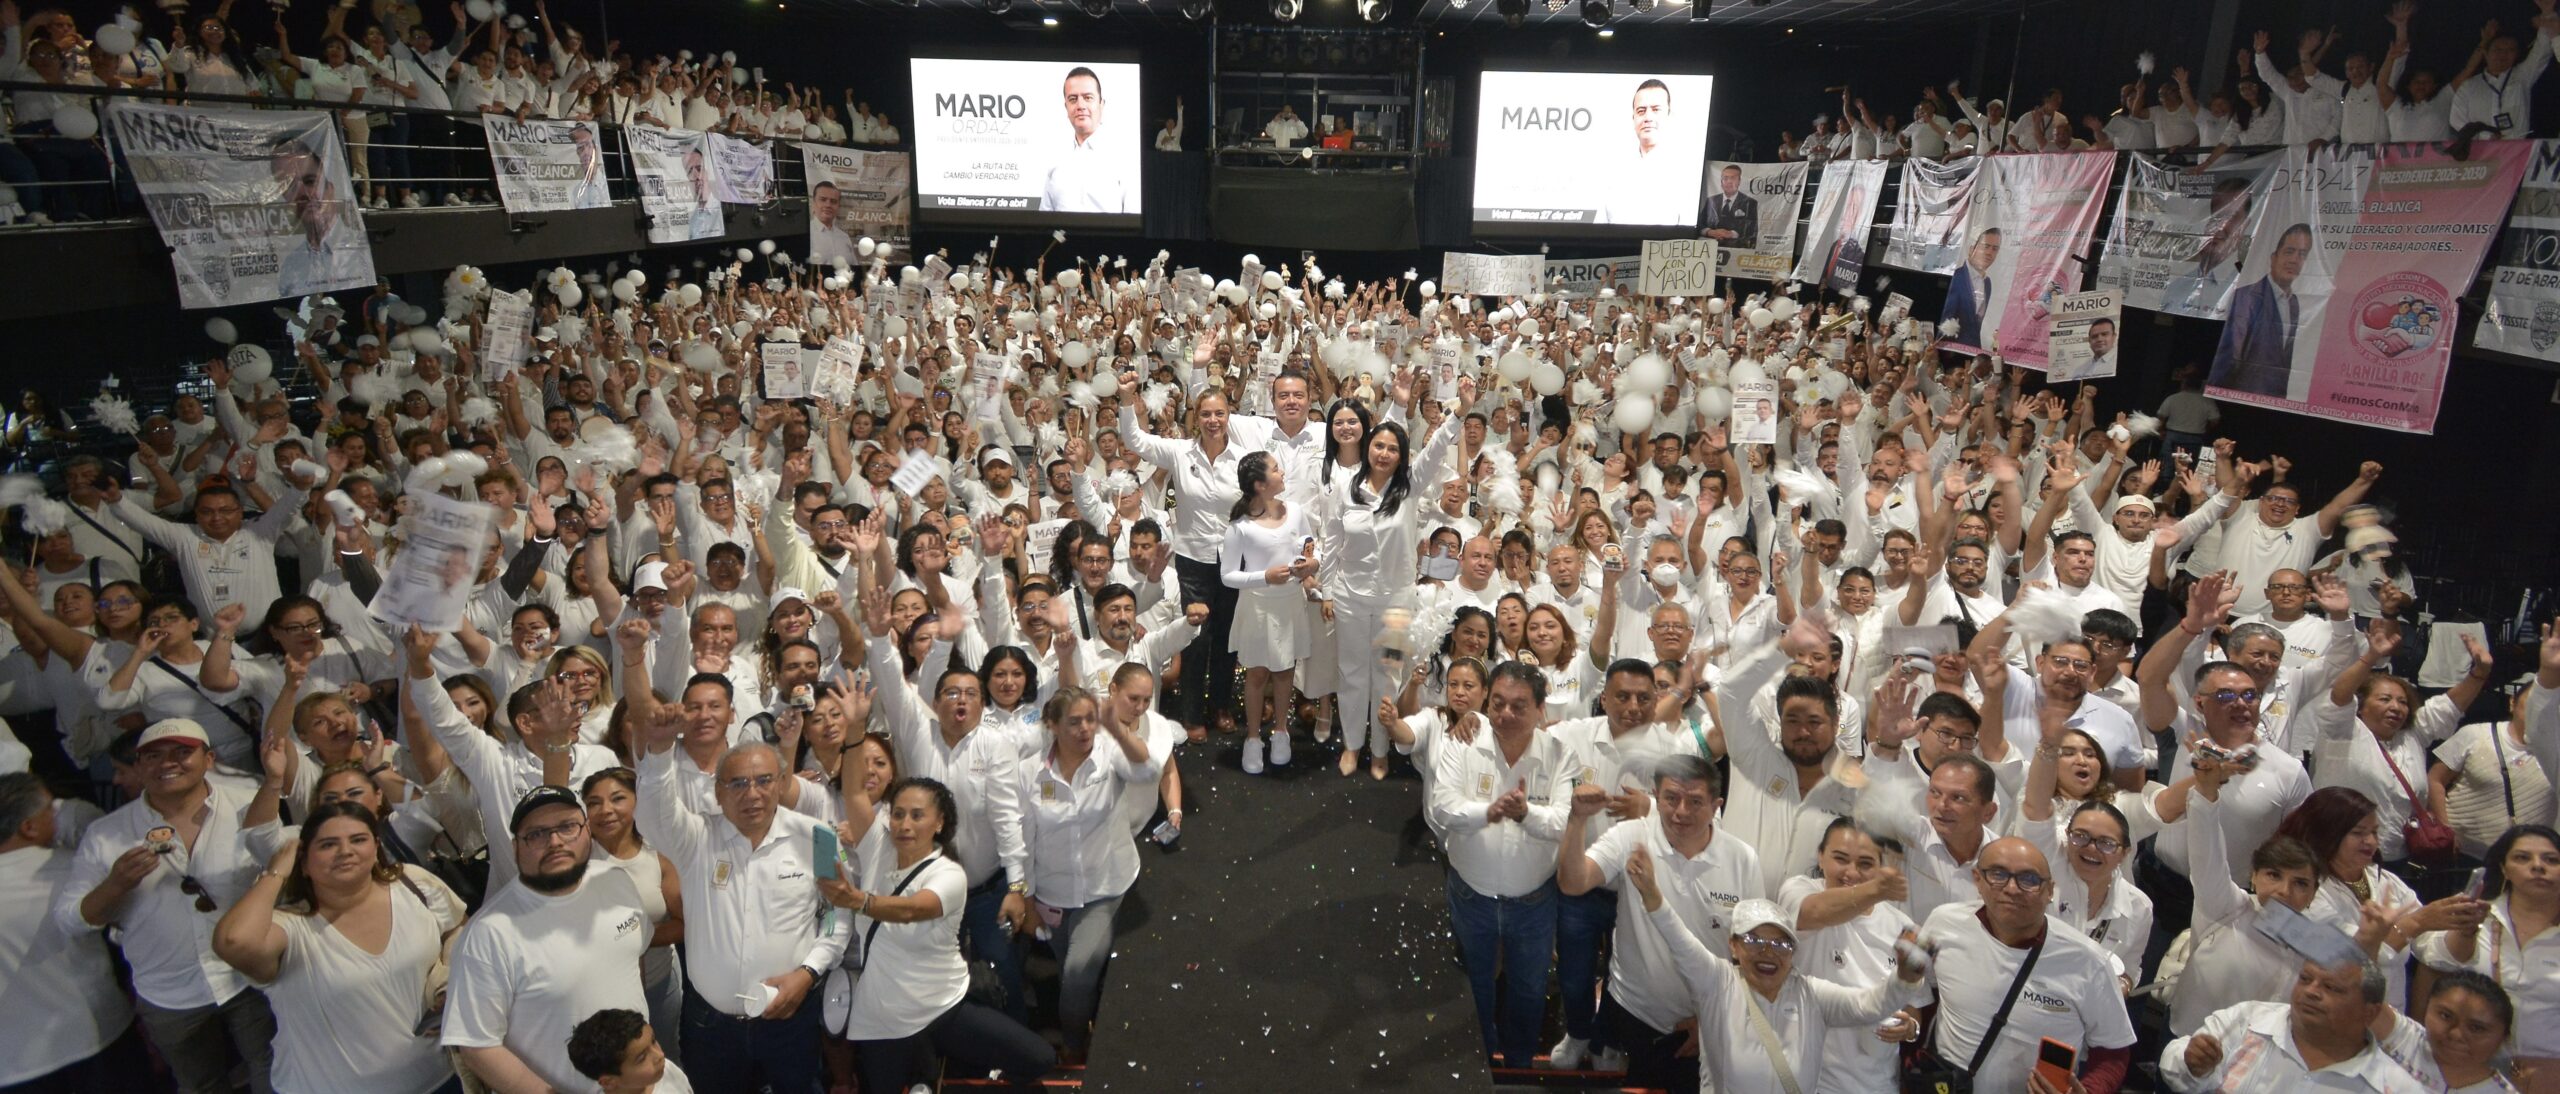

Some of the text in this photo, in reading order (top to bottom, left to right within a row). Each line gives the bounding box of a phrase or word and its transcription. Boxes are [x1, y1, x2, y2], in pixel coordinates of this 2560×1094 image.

[935, 93, 1026, 119] MARIO
[1501, 107, 1592, 131] MARIO
[117, 109, 220, 151] MARIO
[490, 120, 547, 144] MARIO
[952, 119, 1011, 135] ORDAZ
[812, 152, 852, 167] MARIO
[529, 164, 576, 179] BLANCA
[943, 171, 1020, 180] CAMBIO VERDADERO
[2179, 174, 2216, 184] PRESIDENTE
[2378, 166, 2487, 185] PRESIDENTE 2026-2030
[937, 196, 1028, 207] Vota Blanca 27 de abril
[2369, 201, 2423, 213] BLANCA
[217, 209, 292, 234] BLANCA
[847, 210, 893, 223] BLANCA
[2330, 225, 2344, 234] SU
[2346, 224, 2402, 234] LIDERAZGO
[2406, 224, 2411, 233] Y
[1648, 240, 1710, 260] PUEBLA
[2324, 240, 2347, 250] CON
[2350, 241, 2368, 250] LOS
[247, 253, 278, 266] CAMBIO
[1666, 259, 1686, 269] CON
[232, 263, 279, 278] VERDADERO
[1545, 263, 1609, 283] MARIO
[1645, 261, 1706, 294] MARIO
[1836, 266, 1858, 283] MARIO
[2500, 270, 2515, 284] 27
[2516, 272, 2533, 285] DE
[2062, 297, 2110, 312] MARIO
[767, 347, 797, 356] MARIO
[829, 340, 858, 357] MARIO
[2341, 362, 2399, 384] PLANILLA
[1738, 383, 1774, 391] MARIO
[1035, 526, 1064, 539] MAR
[2290, 645, 2316, 655] MARIO
[1710, 891, 1739, 903] MARIO
[2024, 991, 2065, 1006] MARIO
